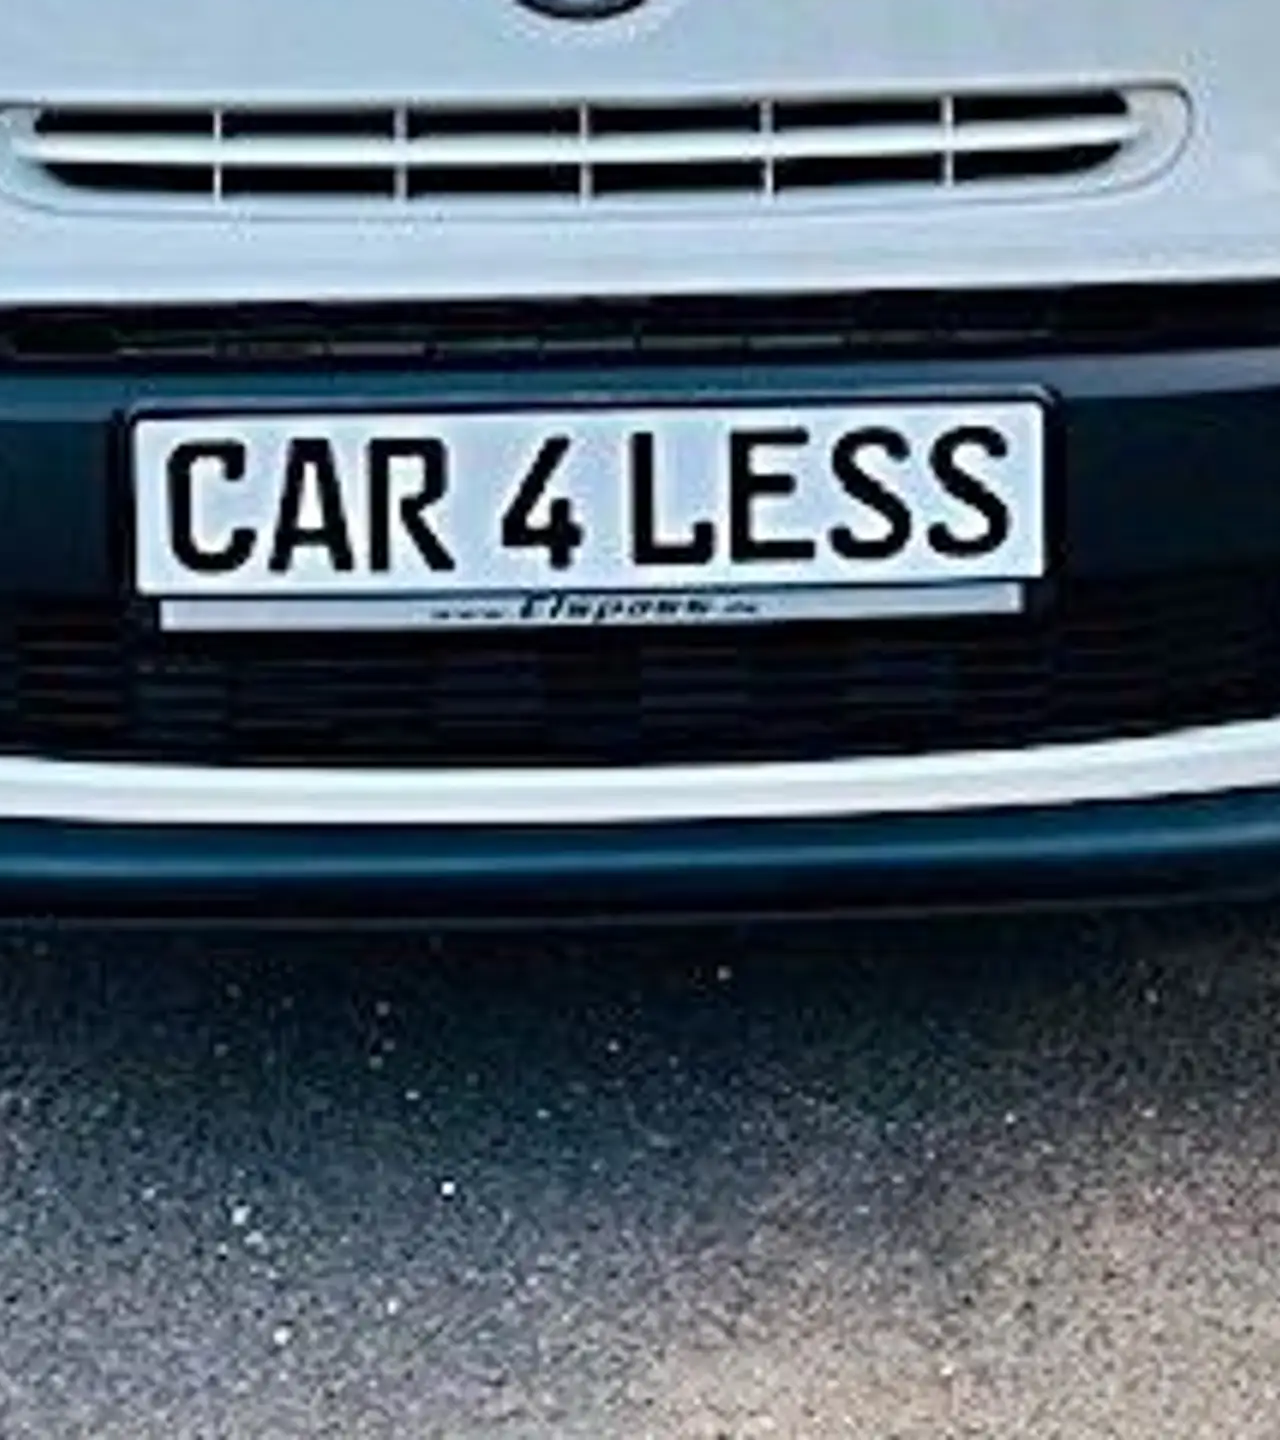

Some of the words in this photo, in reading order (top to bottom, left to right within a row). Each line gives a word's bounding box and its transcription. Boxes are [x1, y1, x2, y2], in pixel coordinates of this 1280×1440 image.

[165, 436, 457, 574] CAR
[500, 435, 585, 570] 4
[630, 424, 1012, 566] LESS
